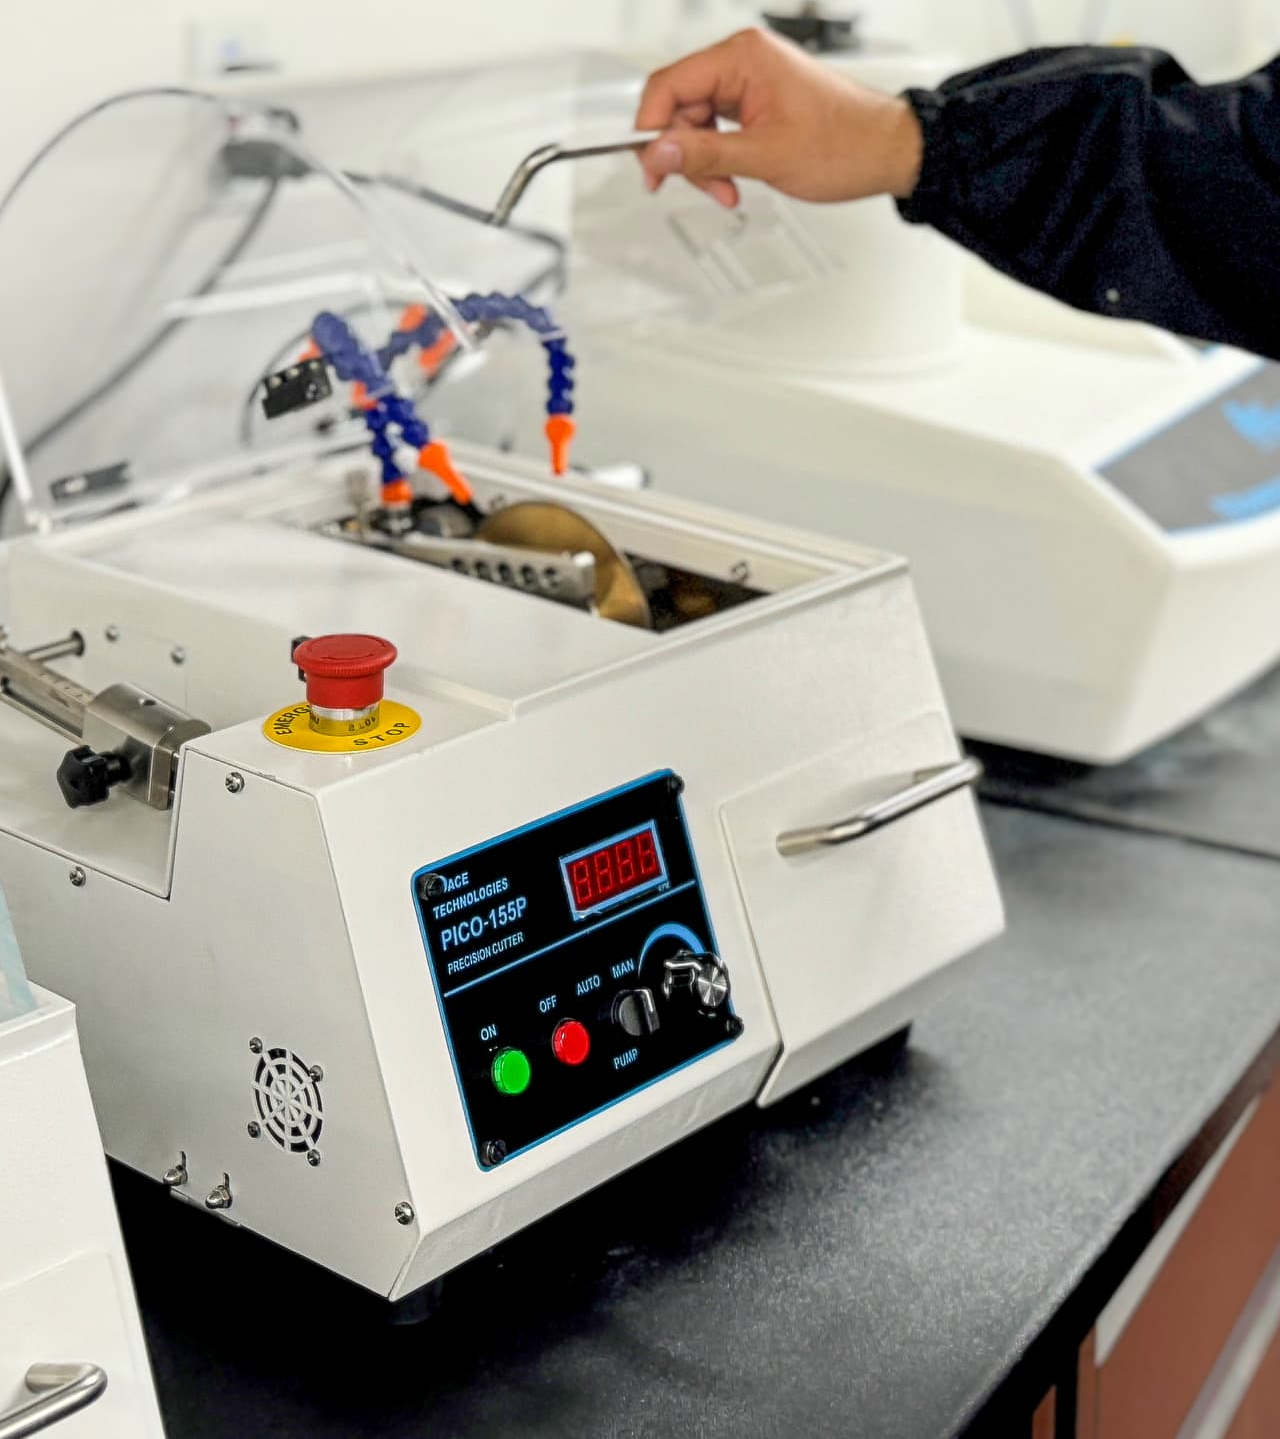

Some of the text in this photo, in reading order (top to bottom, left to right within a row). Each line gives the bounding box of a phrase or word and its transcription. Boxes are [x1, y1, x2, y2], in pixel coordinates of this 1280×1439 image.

[353, 722, 410, 746] STOP
[432, 877, 508, 920] TECHNOLOGIES
[440, 896, 527, 952] PICO-155P
[447, 931, 524, 975] PRECISION CUTTER
[612, 958, 635, 978] MAN
[576, 974, 600, 996] AUTO
[539, 995, 557, 1013] OFF
[480, 1024, 497, 1041] ON
[613, 1048, 638, 1070] PUMP
